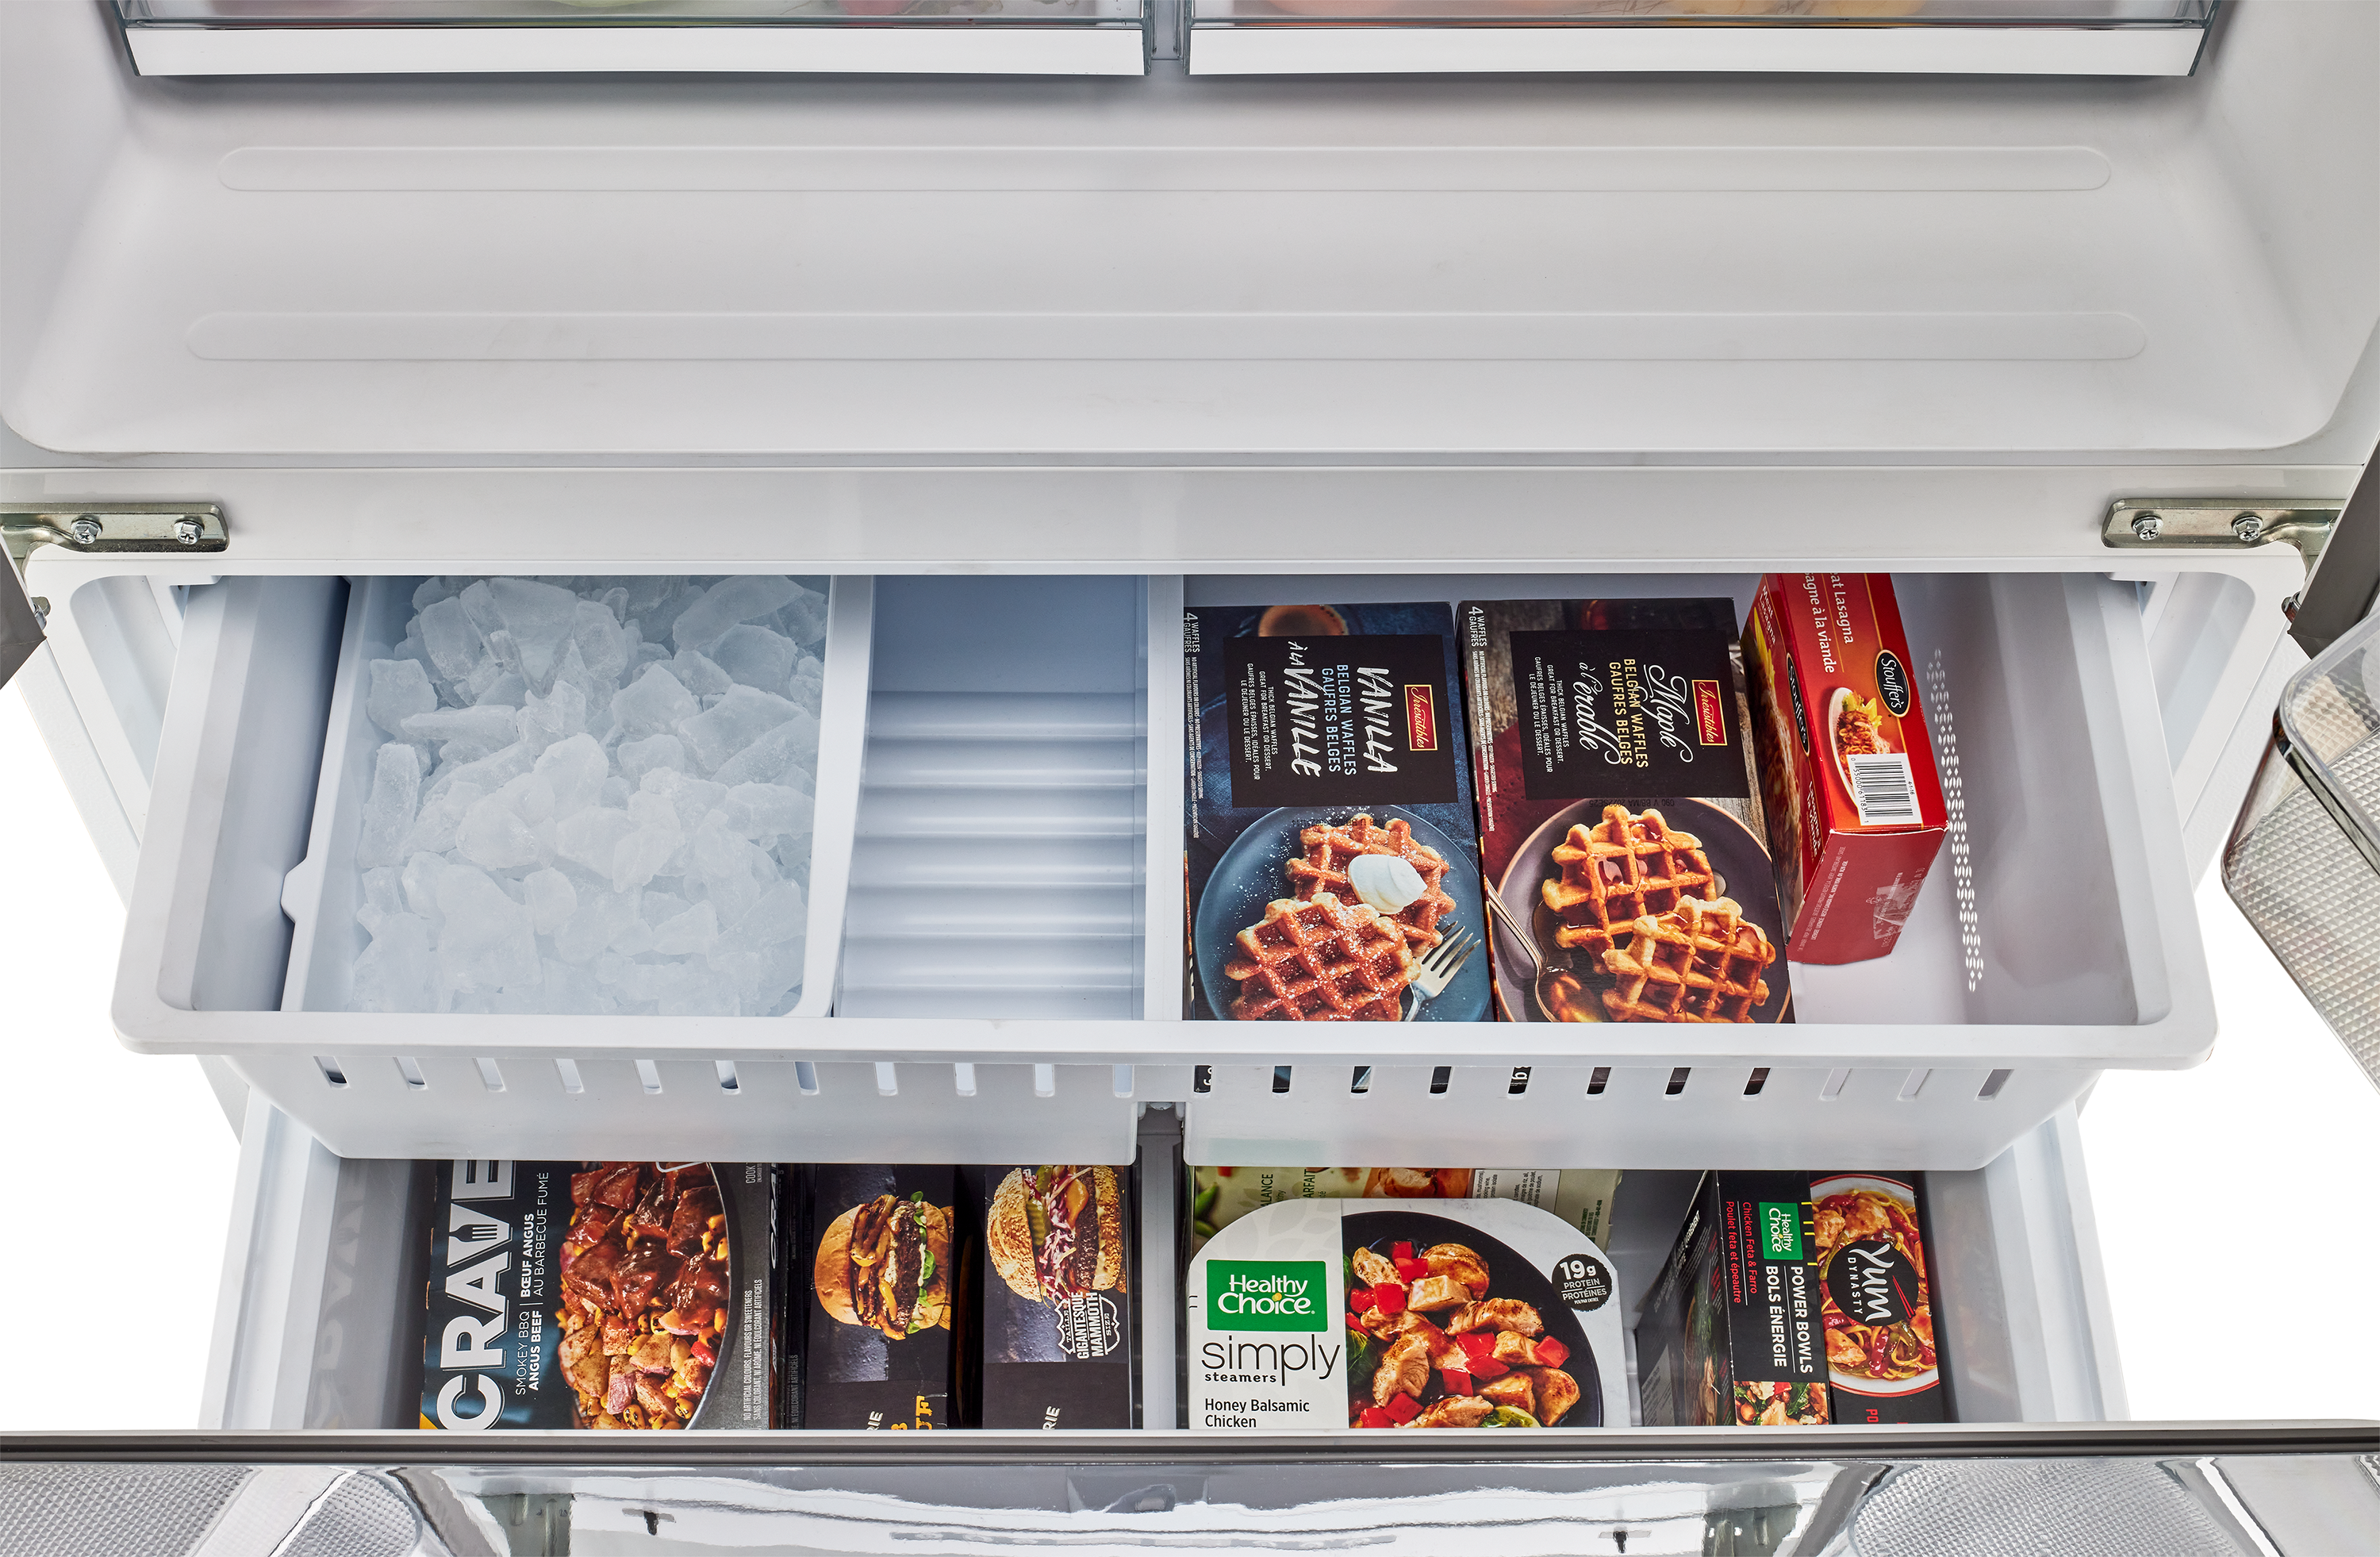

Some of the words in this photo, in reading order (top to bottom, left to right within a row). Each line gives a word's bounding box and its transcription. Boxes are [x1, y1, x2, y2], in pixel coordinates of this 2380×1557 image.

[1830, 573, 1843, 588] at
[1760, 594, 1776, 645] Lasagna
[1762, 586, 1774, 618] Meat
[1833, 591, 1856, 644] Lasagna
[1184, 613, 1198, 621] 4
[1192, 622, 1200, 652] WAFFLES
[1468, 606, 1484, 615] 4
[1478, 616, 1487, 647] WAFFLES
[1469, 617, 1479, 647] GAUFRES
[1814, 617, 1827, 629] la
[1288, 641, 1307, 651] À
[1290, 652, 1306, 665] LA
[1818, 631, 1837, 673] viande
[1578, 662, 1595, 671] à
[1624, 659, 1642, 709] BELGIAN
[1880, 659, 1904, 708] Stouffer's
[1322, 668, 1338, 721] GAUFRES
[1337, 665, 1352, 713] BELGIAN
[1530, 682, 1539, 709] DÉJEUNER
[1534, 657, 1543, 681] GAUFRES
[1540, 705, 1549, 732] ÉPAISSES,
[1609, 662, 1627, 715] GAUFRES
[1787, 666, 1808, 744] Stouffer's
[1284, 667, 1326, 777] VANILLE
[1357, 667, 1398, 773] VANILLA
[1410, 686, 1428, 749] Irresistibles
[1533, 711, 1540, 720] OU
[1550, 696, 1560, 726] BREAKFAST
[1555, 737, 1564, 763] DESSERT.
[1573, 672, 1622, 764] l'érable
[1640, 664, 1694, 763] Maple
[1696, 682, 1715, 743] Irresistibles
[1326, 726, 1341, 772] BELGES
[1341, 720, 1357, 775] WAFFLES
[1535, 729, 1544, 755] DESSERT.
[1616, 720, 1633, 764] BELGES
[1630, 713, 1649, 767] WAFFLES
[1809, 781, 1820, 835] Lasagne
[1858, 791, 1868, 811] 61183
[1807, 809, 1818, 857] viande
[536, 1173, 548, 1205] FUMÉ
[746, 1165, 756, 1183] COOK
[1261, 1174, 1273, 1206] ALANCE
[1303, 1169, 1315, 1198] ARFAIT
[1726, 1201, 1736, 1229] Poulet
[1742, 1201, 1754, 1236] Chicken
[1768, 1208, 1783, 1252] Choice
[1781, 1213, 1793, 1251] Healthy
[523, 1213, 534, 1257] ANGUS
[534, 1209, 547, 1275] BARBECUE
[1729, 1232, 1737, 1249] feta
[1745, 1239, 1756, 1259] Feta
[1729, 1251, 1737, 1260] et
[436, 1159, 515, 1430] CRAVE
[520, 1260, 532, 1298] BŒUF
[533, 1279, 543, 1297] AU
[754, 1279, 762, 1308] ARTIFICIELS
[1229, 1274, 1308, 1298] Healthy
[1563, 1288, 1606, 1300] PROTÉINES
[1564, 1278, 1600, 1289] PROTEIN
[1729, 1264, 1741, 1303] épeautre
[1749, 1270, 1758, 1294] Farro
[1765, 1266, 1781, 1302] BOLS
[1791, 1267, 1807, 1317] POWER
[1848, 1243, 1894, 1322] Yum
[1848, 1257, 1863, 1314] DYNASTY
[1217, 1292, 1311, 1316] Choice
[518, 1312, 529, 1338] BBQ
[531, 1310, 542, 1342] BEEF
[1071, 1292, 1089, 1359] GIGANTESQUE
[1086, 1292, 1104, 1357] MAMMOTH
[1769, 1305, 1787, 1367] ÉNERGIE
[743, 1332, 754, 1358] FLAVOURS
[752, 1349, 762, 1369] ARÔME,
[1202, 1335, 1341, 1386] simply
[1796, 1321, 1813, 1374] BOWLS
[515, 1343, 530, 1395] SMOKEY
[528, 1345, 543, 1390] ANGUS
[743, 1358, 754, 1384] COLOURS,
[1205, 1373, 1276, 1383] steamers
[1205, 1399, 1247, 1414] Honey
[1251, 1398, 1310, 1412] Balsamic
[1205, 1415, 1257, 1428] Chicken
